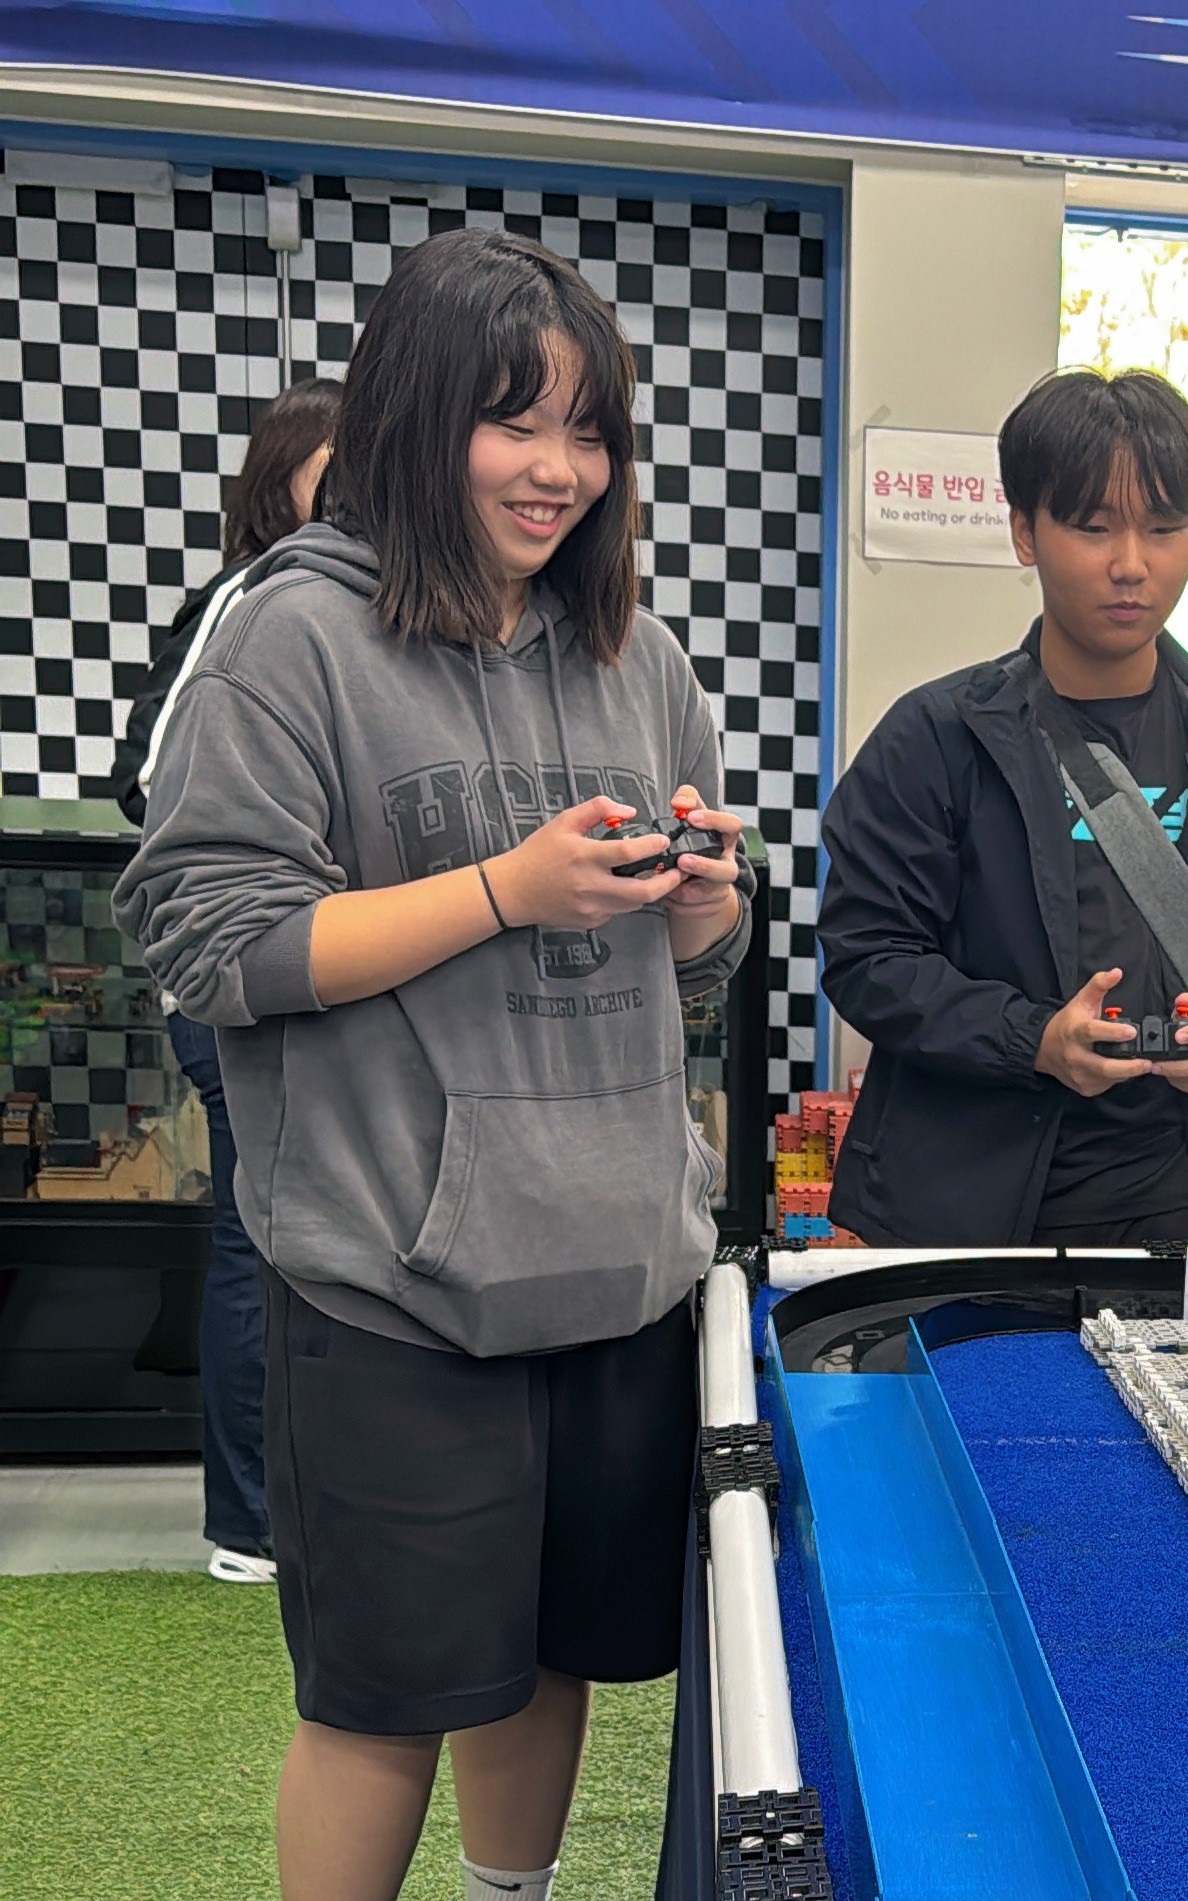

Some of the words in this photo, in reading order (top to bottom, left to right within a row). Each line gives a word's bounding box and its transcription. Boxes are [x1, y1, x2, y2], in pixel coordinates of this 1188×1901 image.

[873, 470, 934, 500] 음식물
[943, 475, 985, 502] 반입
[881, 507, 899, 520] No
[903, 510, 947, 525] eating
[950, 513, 966, 523] or
[970, 512, 1008, 526] drink
[584, 987, 643, 1016] ARCHIVE
